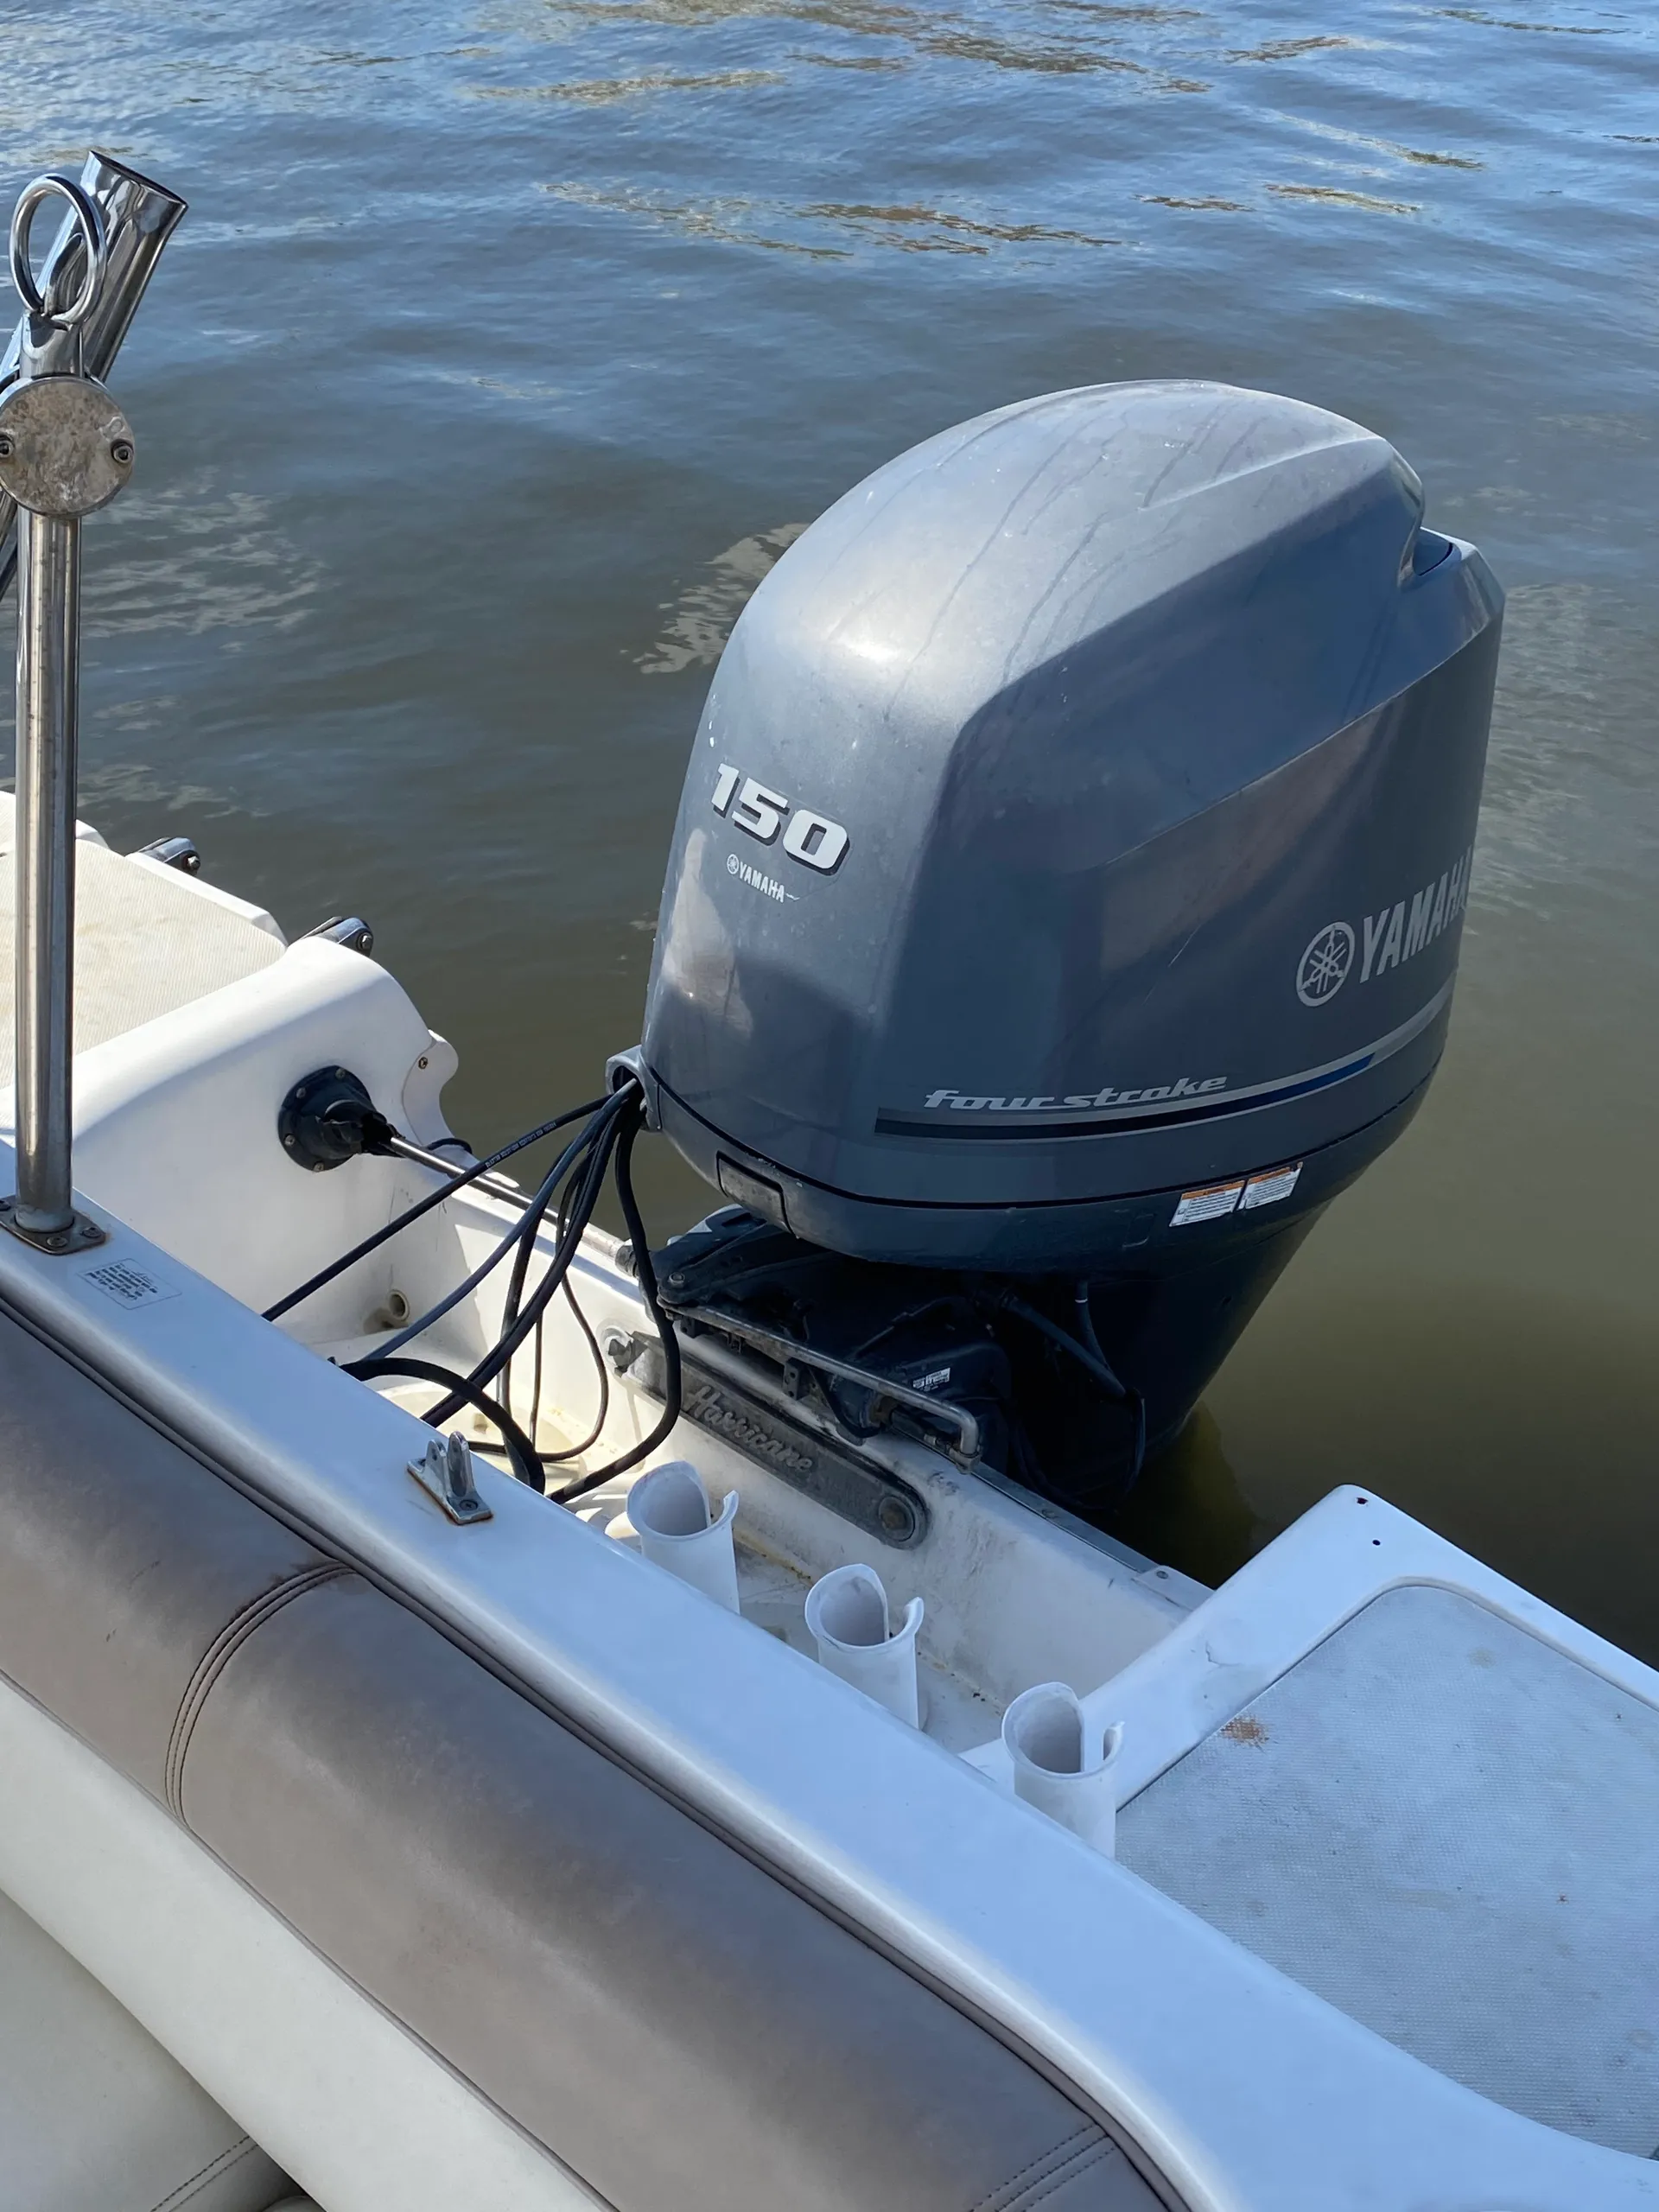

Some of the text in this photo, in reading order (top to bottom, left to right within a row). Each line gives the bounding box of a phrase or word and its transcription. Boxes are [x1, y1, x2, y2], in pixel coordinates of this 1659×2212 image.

[711, 763, 850, 876] 150
[739, 861, 785, 903] YAMAHA
[924, 1076, 1227, 1110] four stroke
